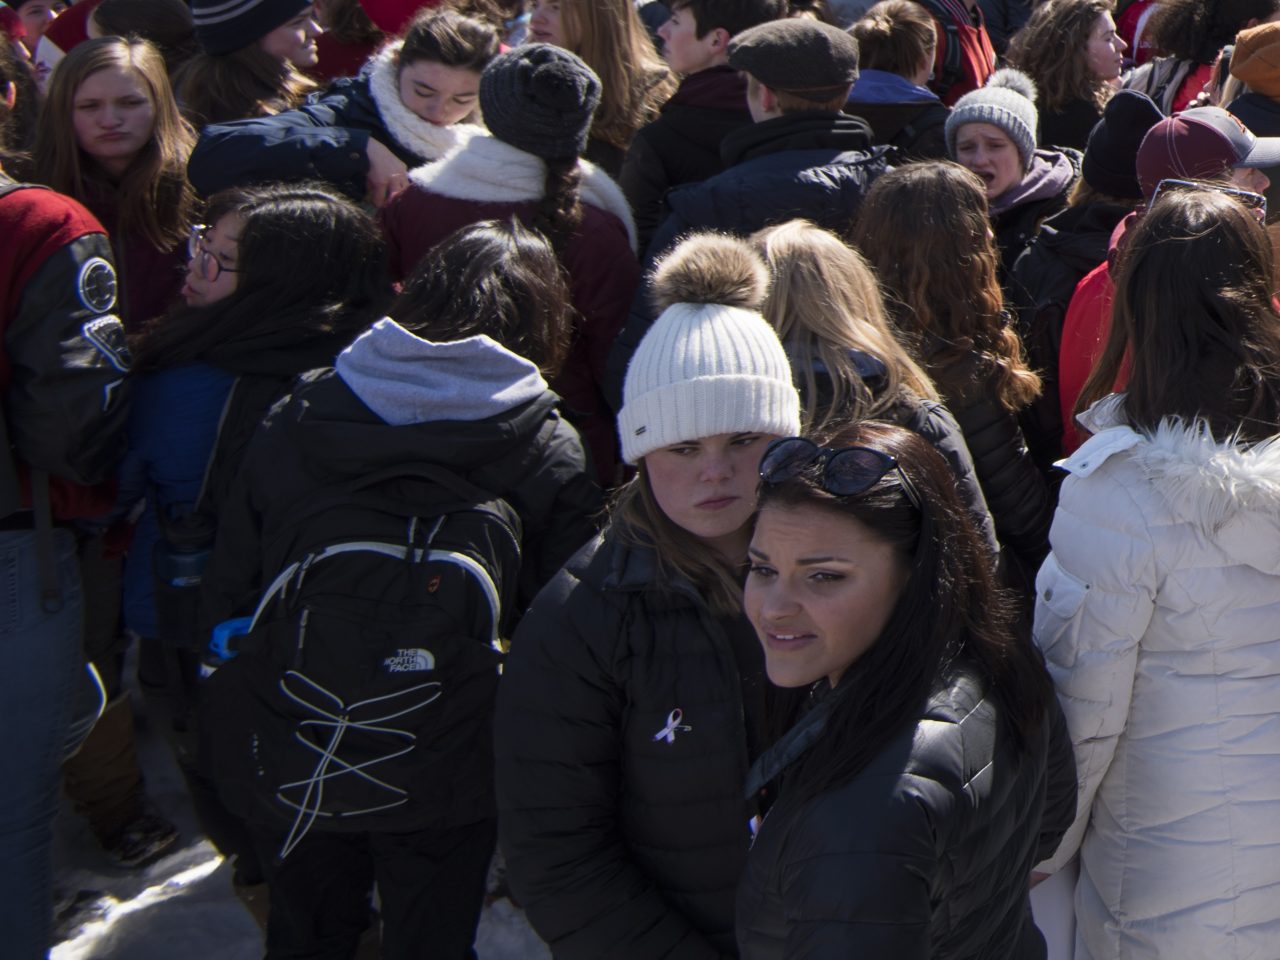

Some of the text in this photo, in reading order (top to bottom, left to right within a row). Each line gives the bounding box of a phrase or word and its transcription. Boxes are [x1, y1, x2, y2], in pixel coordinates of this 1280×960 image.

[397, 649, 417, 657] THE
[384, 656, 417, 666] NORTH
[389, 664, 416, 672] FACE
